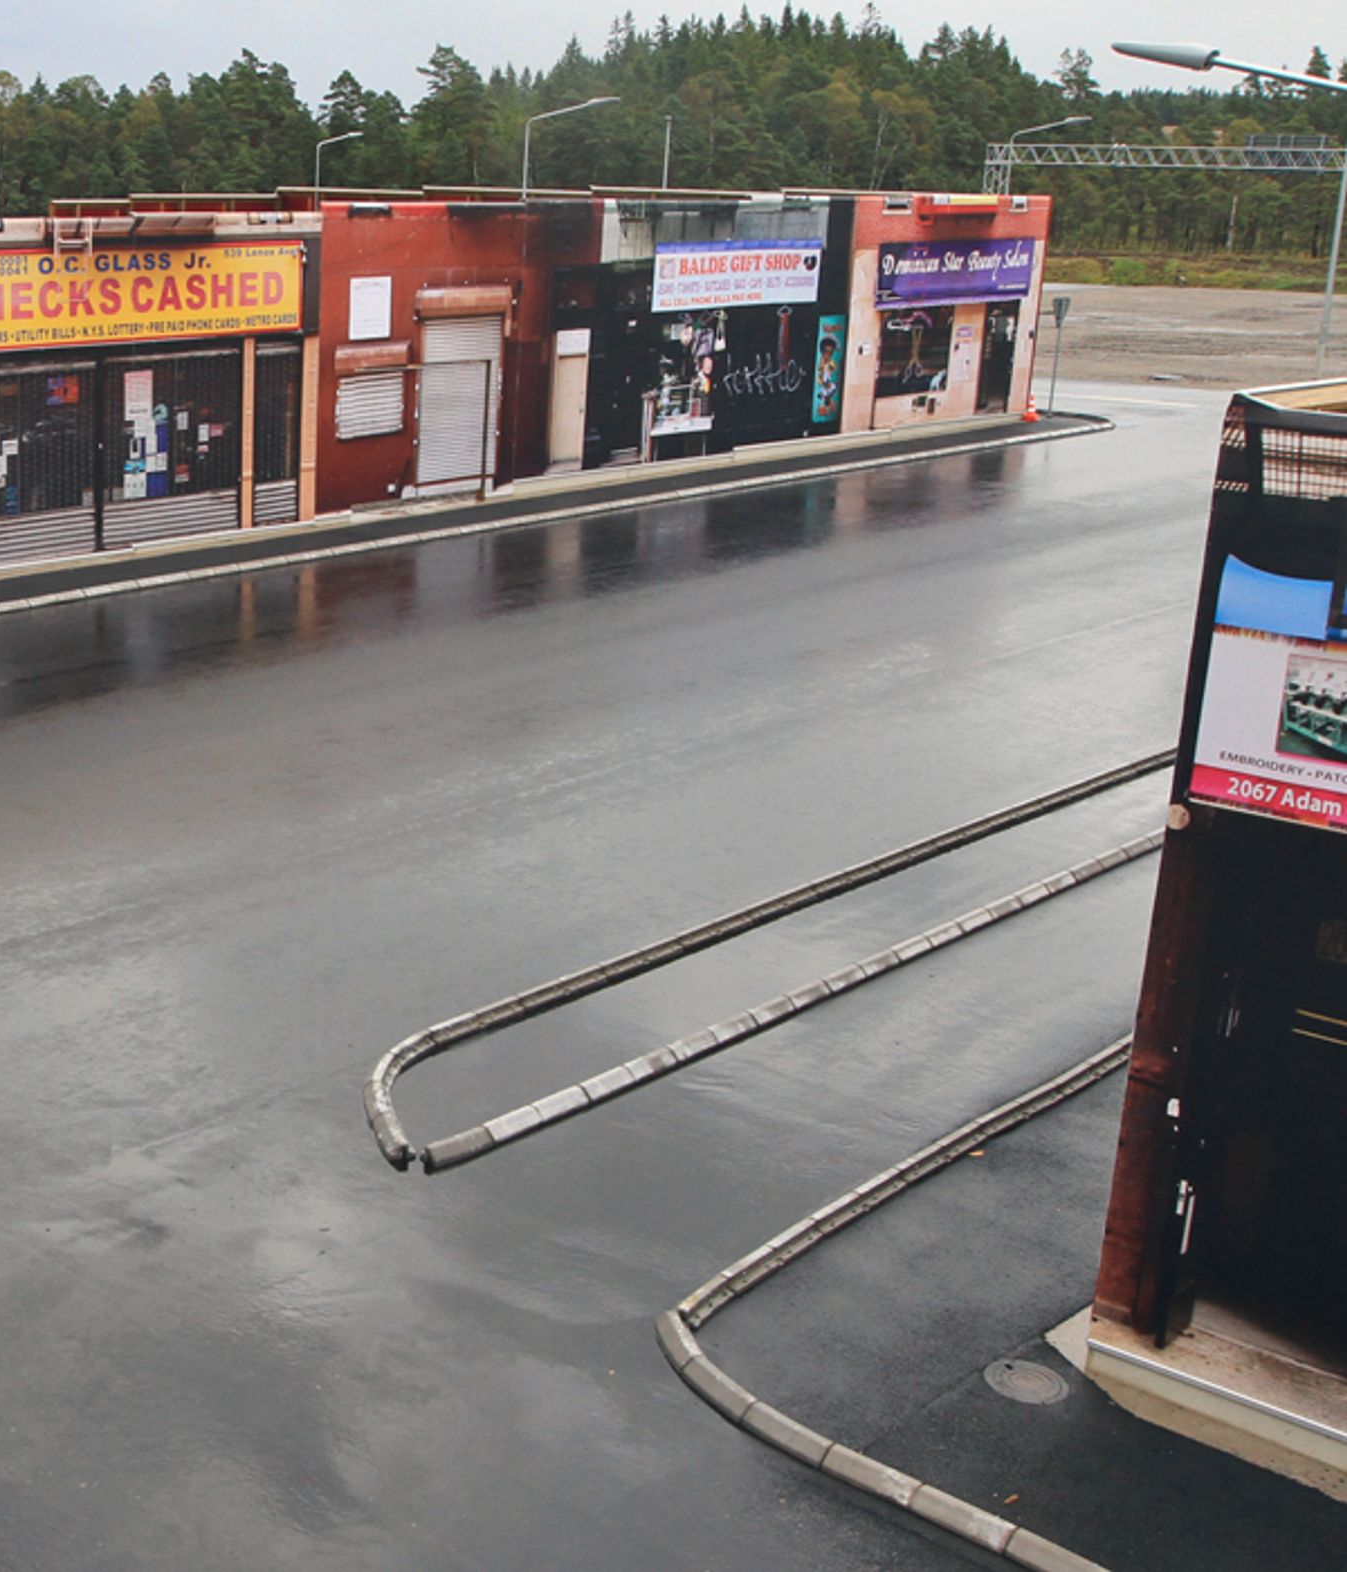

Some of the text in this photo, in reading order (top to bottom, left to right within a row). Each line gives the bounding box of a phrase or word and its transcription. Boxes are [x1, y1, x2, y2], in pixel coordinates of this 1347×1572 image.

[38, 252, 212, 274] O.C. GLASS Jr.
[679, 254, 802, 276] BALDE GIFT SHOP
[882, 240, 1030, 282] Dominican Star Beauty Salon
[131, 271, 285, 314] CASHED
[15, 328, 50, 342] UTILITY
[52, 327, 76, 340] BILLS
[109, 322, 145, 336] LOTTERY
[1219, 750, 1306, 777] EMBROIDERY
[1227, 776, 1343, 817] 2067 Adam
